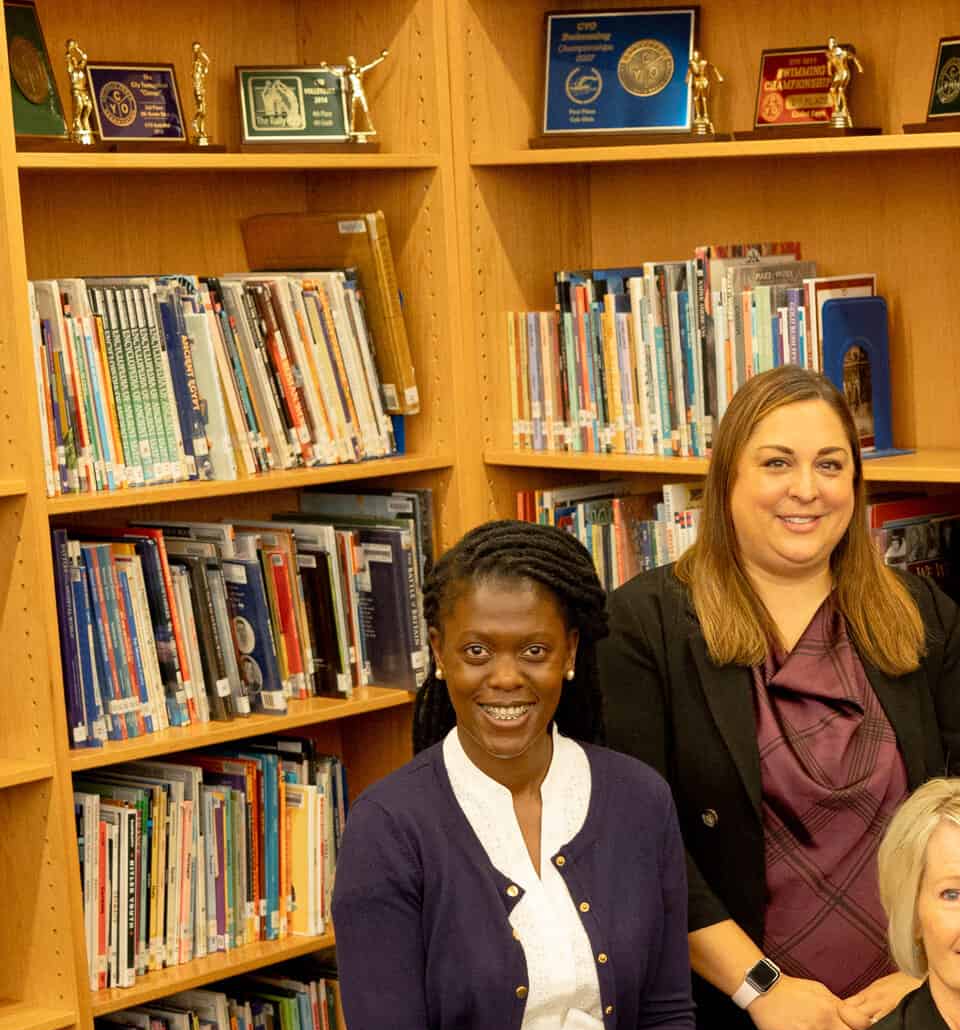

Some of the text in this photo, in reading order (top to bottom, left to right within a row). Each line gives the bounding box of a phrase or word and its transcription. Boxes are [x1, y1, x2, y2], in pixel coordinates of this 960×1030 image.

[110, 103, 129, 114] Y O
[113, 90, 121, 101] C
[124, 328, 139, 391] ENCYCLOPEDIA
[181, 335, 201, 411] ANCIENT EGYPT
